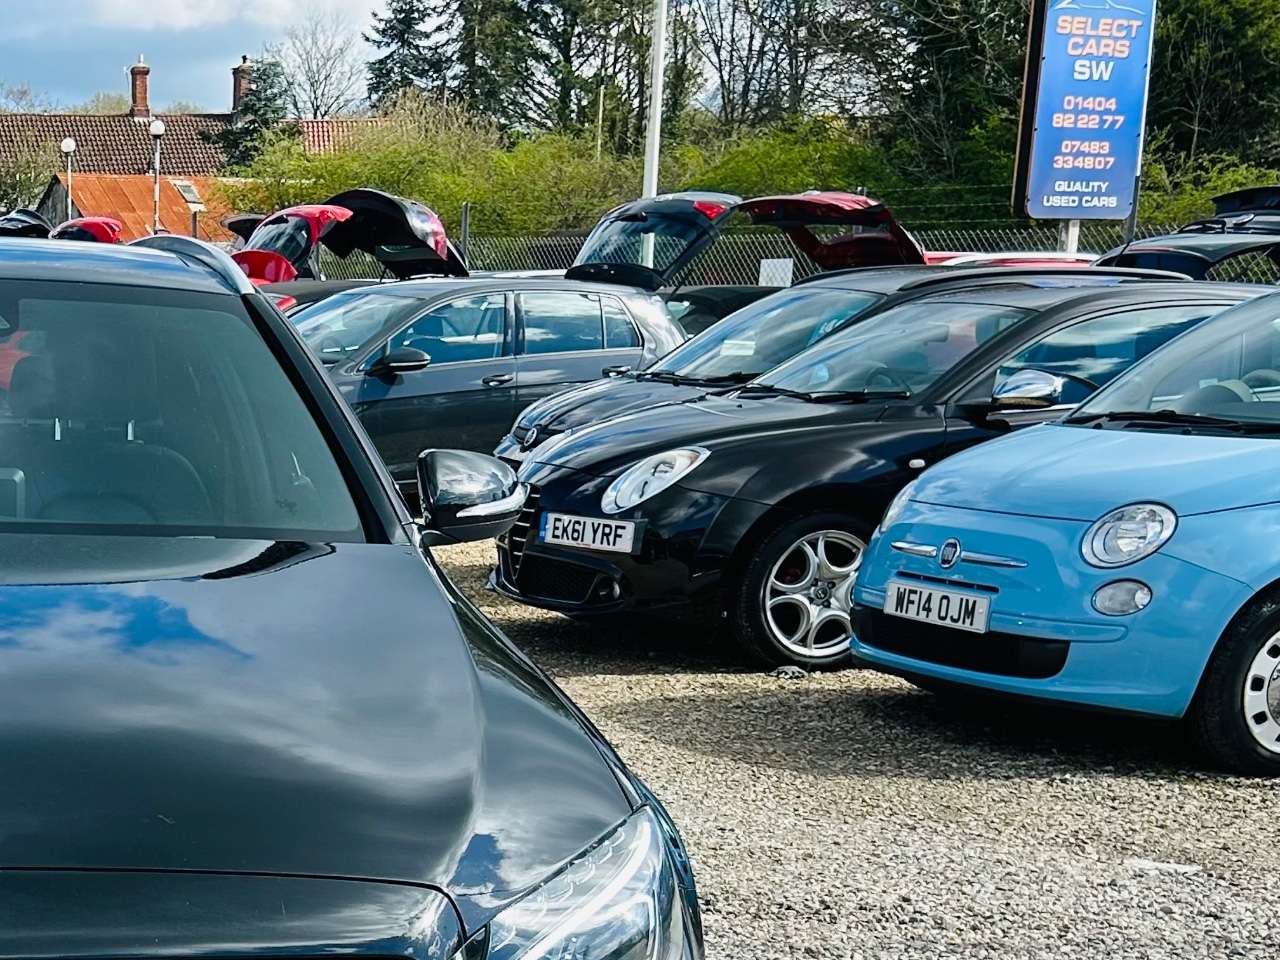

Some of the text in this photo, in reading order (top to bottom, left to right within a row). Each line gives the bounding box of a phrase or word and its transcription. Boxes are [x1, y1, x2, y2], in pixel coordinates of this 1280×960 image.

[1056, 15, 1143, 38] SELECT
[1067, 36, 1130, 58] CARS
[1073, 59, 1114, 81] SW
[1063, 95, 1117, 111] 01404
[1061, 140, 1110, 154] 07483
[1053, 156, 1115, 170] 334807
[1054, 181, 1109, 193] QUALITY
[1043, 195, 1118, 208] USED CARS
[551, 517, 627, 547] EK61 YRF
[894, 586, 978, 627] WF14 OJM
